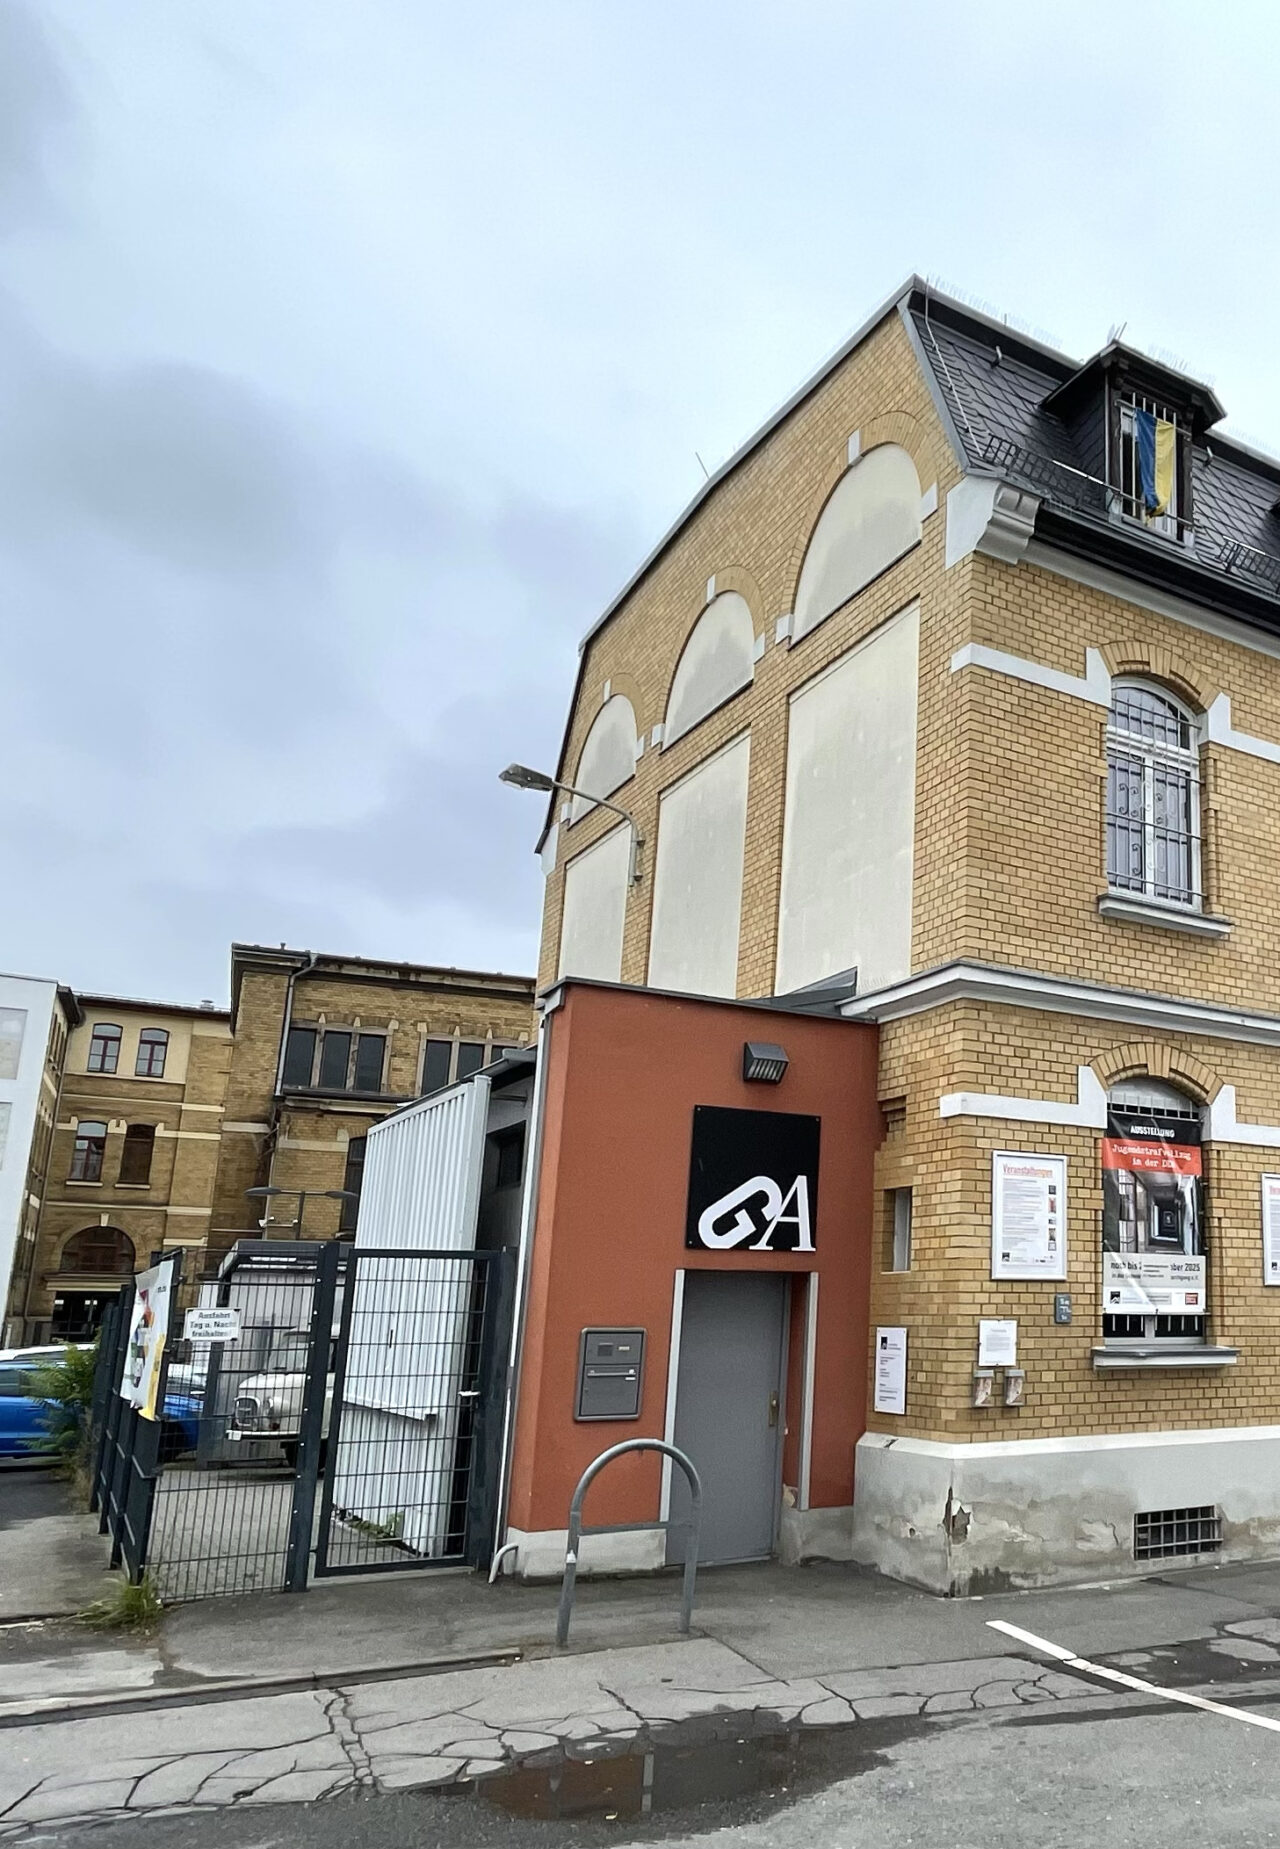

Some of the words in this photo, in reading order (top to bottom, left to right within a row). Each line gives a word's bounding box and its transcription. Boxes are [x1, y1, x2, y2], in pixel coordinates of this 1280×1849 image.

[1130, 1125, 1175, 1138] AUSSTELLUNG
[1112, 1143, 1192, 1161] Jugendstrafvollzug
[1132, 1157, 1141, 1166] in
[1145, 1158, 1159, 1167] der
[1003, 1163, 1053, 1179] Veranstaltungen
[199, 1311, 231, 1319] Ausfahrt
[190, 1321, 203, 1329] Tag
